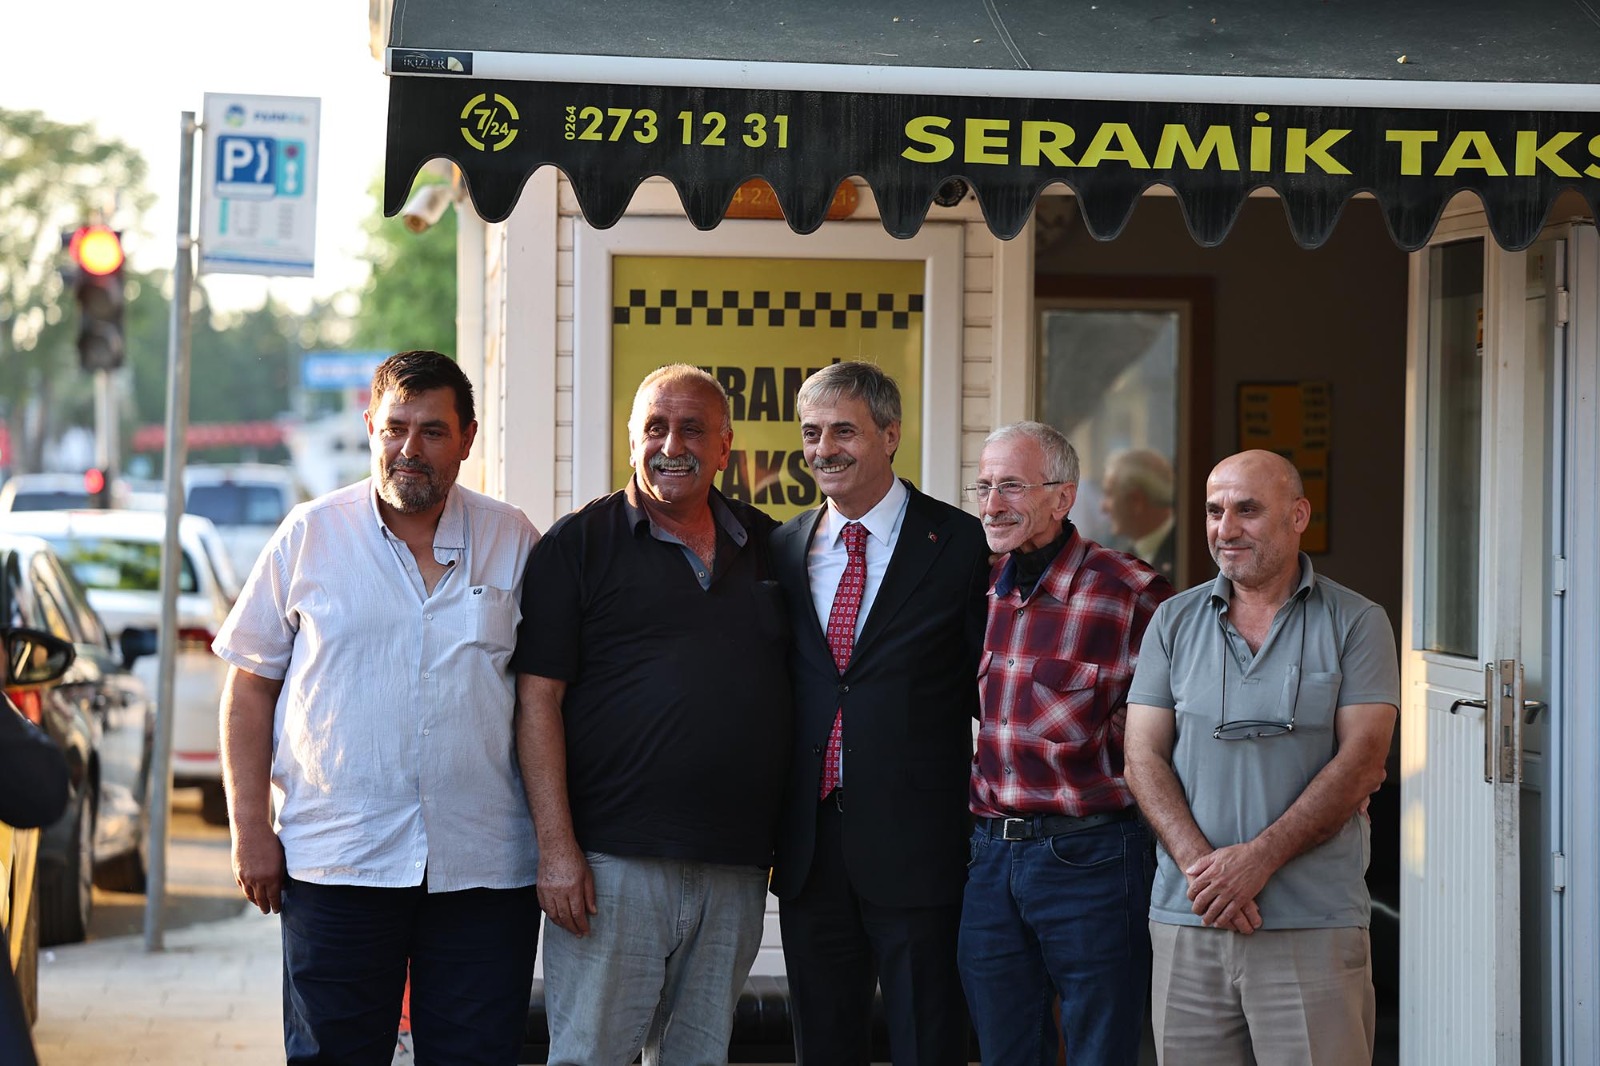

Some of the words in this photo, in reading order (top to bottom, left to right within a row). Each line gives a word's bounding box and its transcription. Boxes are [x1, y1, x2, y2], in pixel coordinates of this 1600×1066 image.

[473, 107, 510, 139] 7/24
[564, 105, 577, 141] 0264
[577, 106, 659, 144] 273
[677, 110, 727, 147] 12
[742, 112, 789, 149] 31
[901, 111, 1352, 175] SERAMİK
[720, 448, 831, 507] AKS
